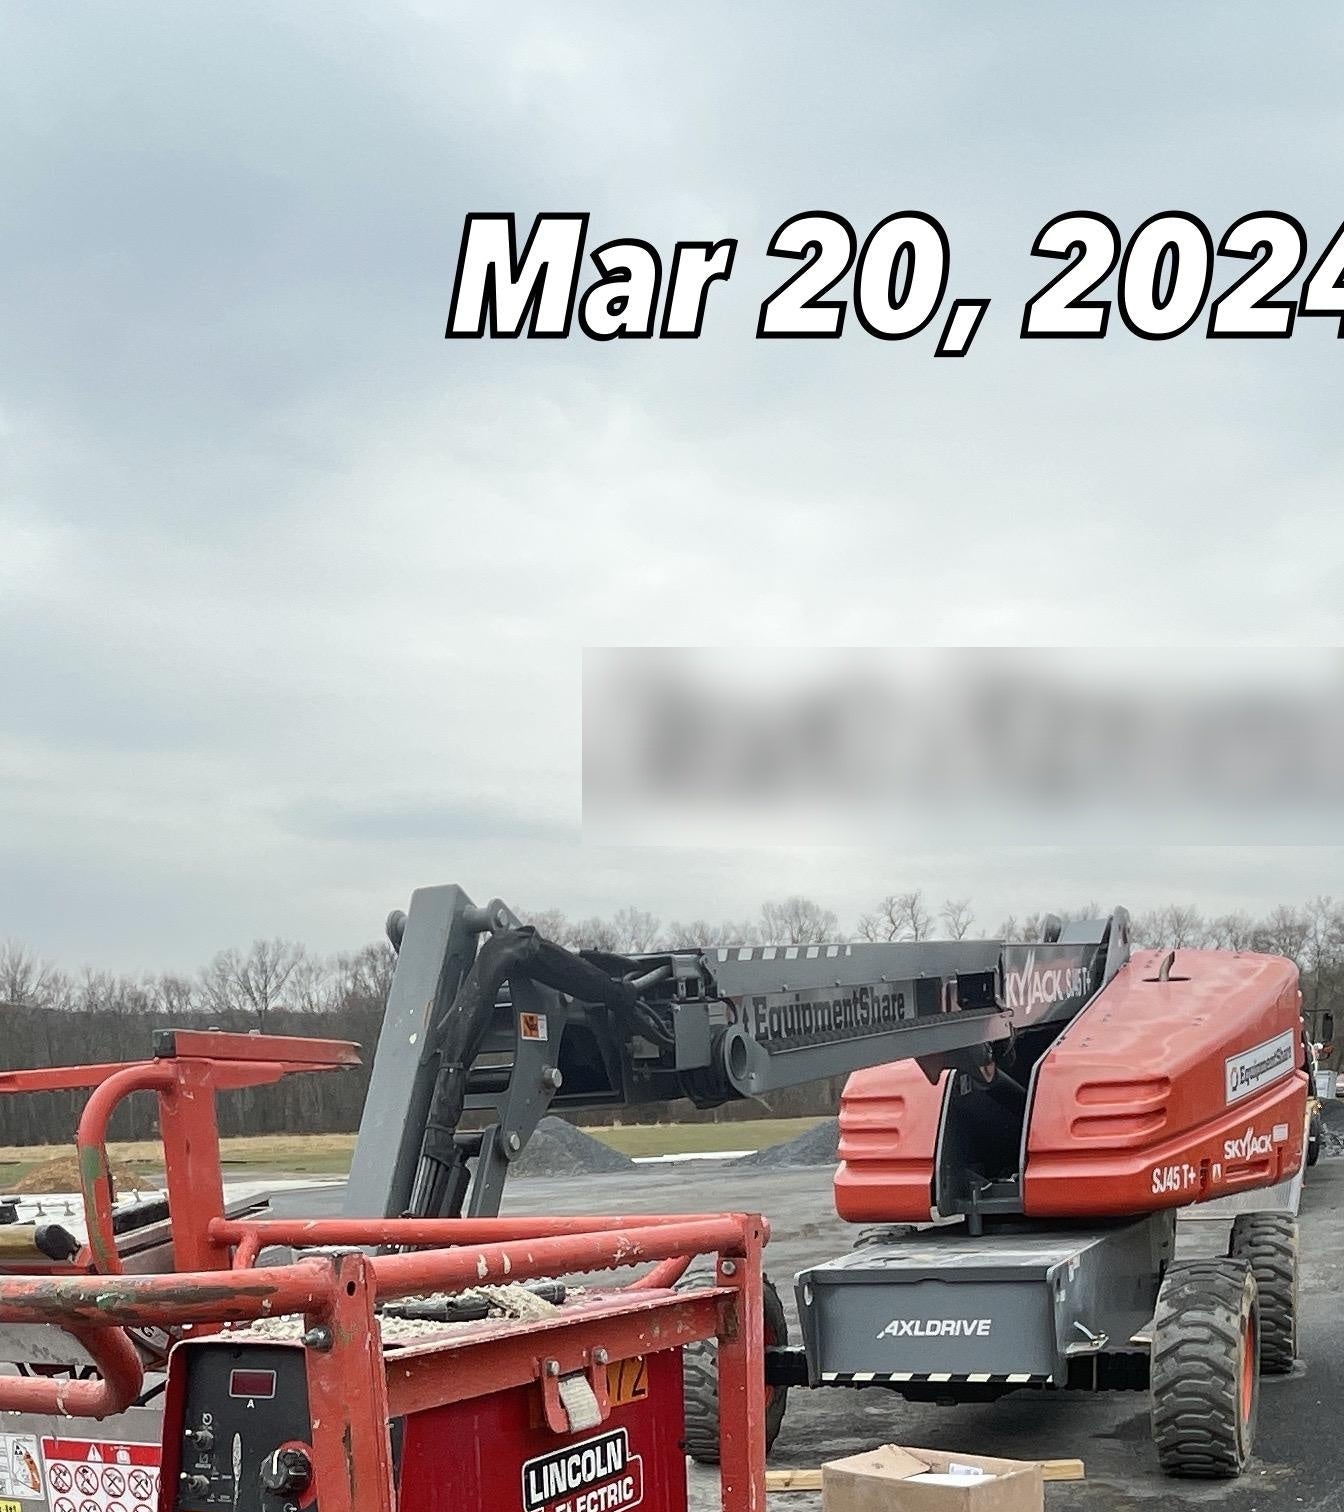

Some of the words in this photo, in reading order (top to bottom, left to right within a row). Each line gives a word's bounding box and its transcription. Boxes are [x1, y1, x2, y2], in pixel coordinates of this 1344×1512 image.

[1006, 950, 1064, 1014] KYJACK
[752, 986, 905, 1041] EquipmentShare
[1224, 1127, 1273, 1161] SKYJACK
[876, 1319, 992, 1339] AXLDRIVE
[529, 1438, 624, 1504] LINCOLN
